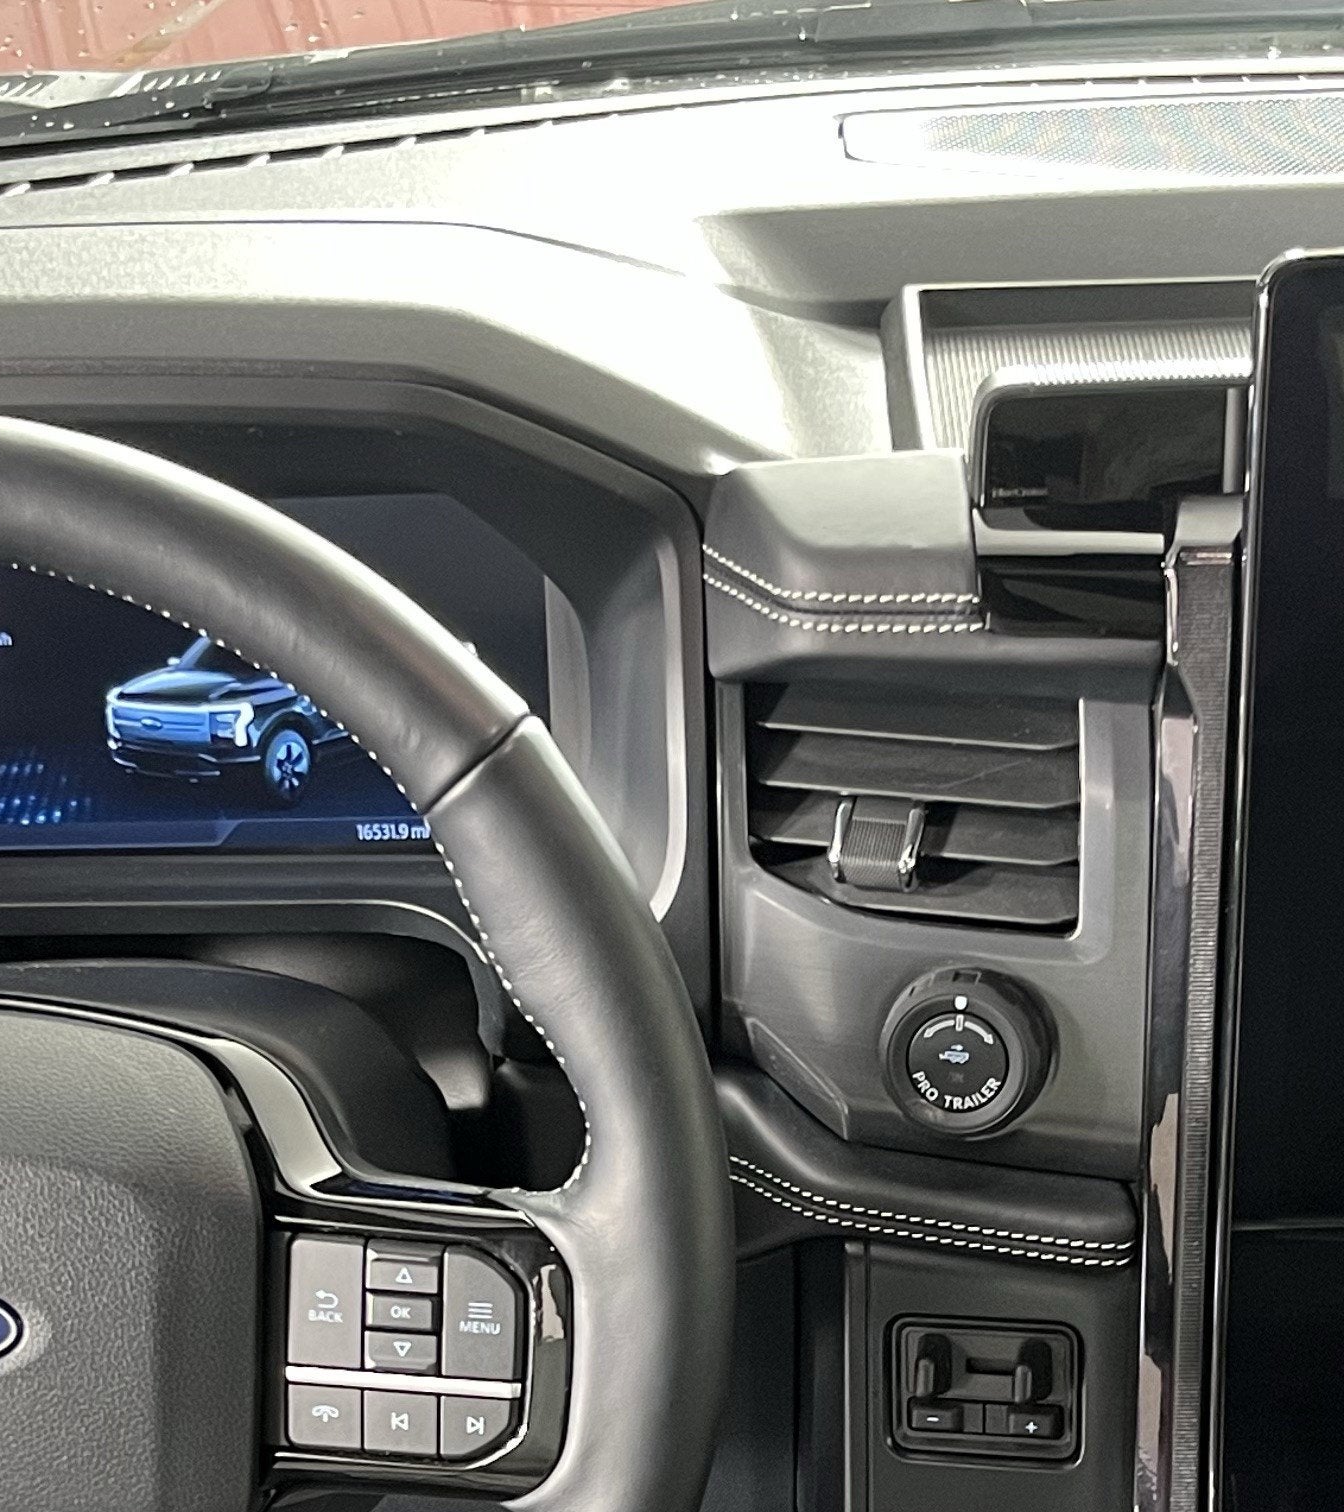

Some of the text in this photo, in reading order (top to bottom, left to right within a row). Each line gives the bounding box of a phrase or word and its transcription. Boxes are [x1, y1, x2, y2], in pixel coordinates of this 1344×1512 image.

[912, 1070, 939, 1102] PRO
[943, 1077, 1002, 1110] TRAILER
[308, 1310, 343, 1323] BACK
[390, 1306, 411, 1319] OK
[459, 1321, 500, 1334] MENU
